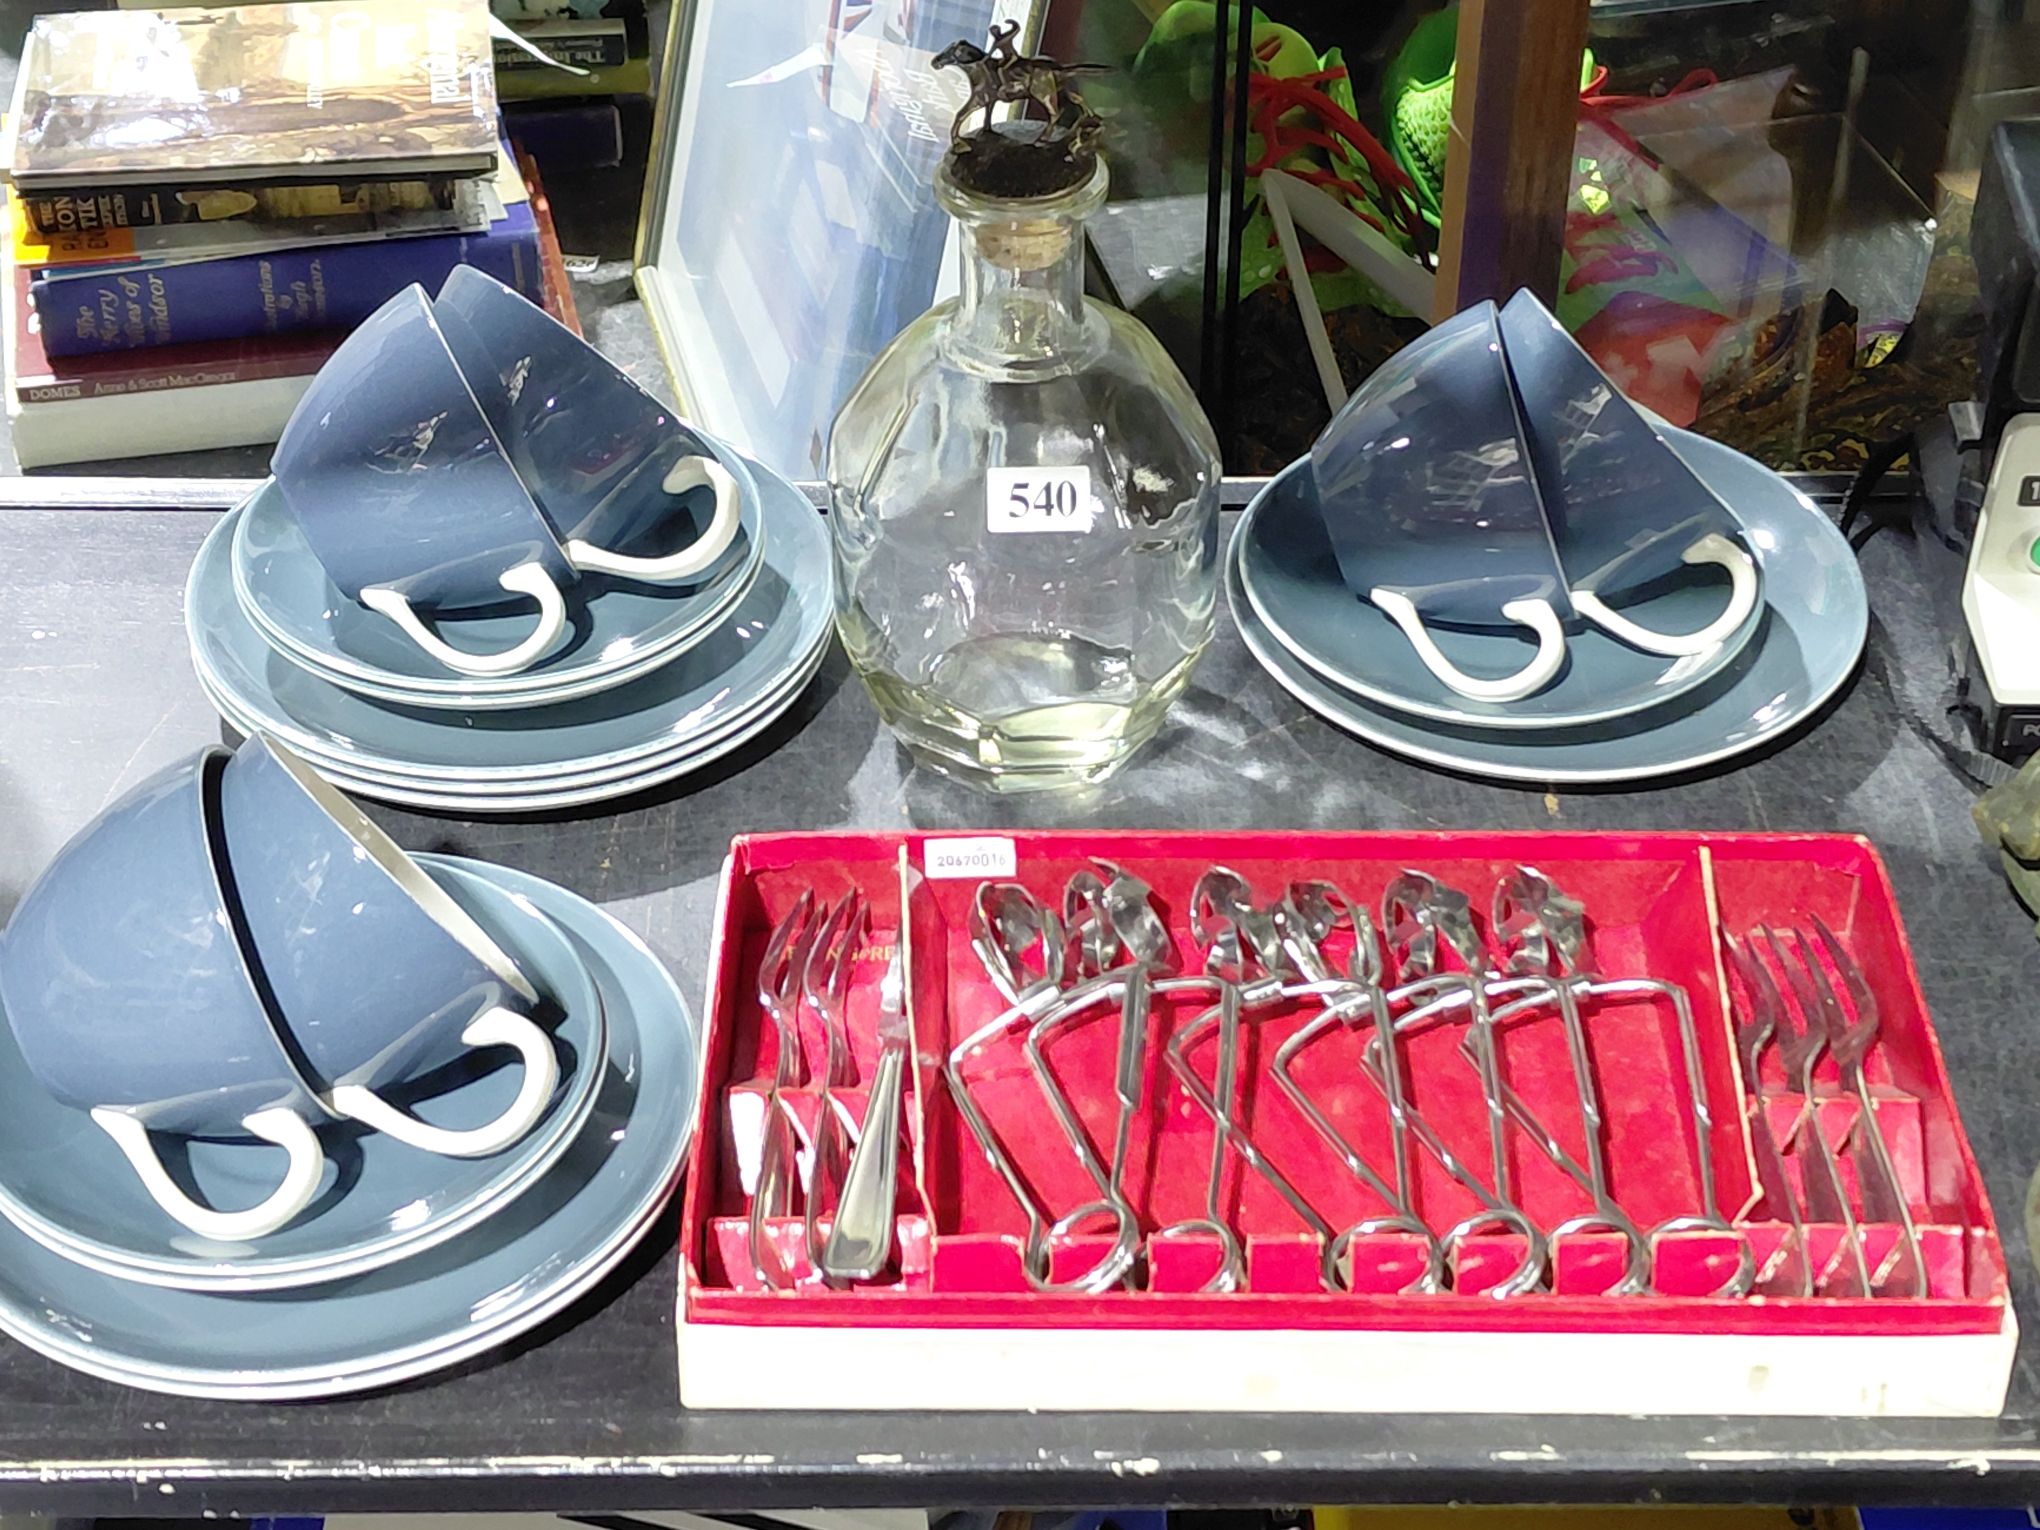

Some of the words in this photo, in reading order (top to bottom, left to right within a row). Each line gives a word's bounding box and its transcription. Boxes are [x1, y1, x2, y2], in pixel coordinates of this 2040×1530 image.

[29, 385, 82, 401] DOMES
[1008, 480, 1077, 518] 540
[937, 853, 1007, 867] 20670016
